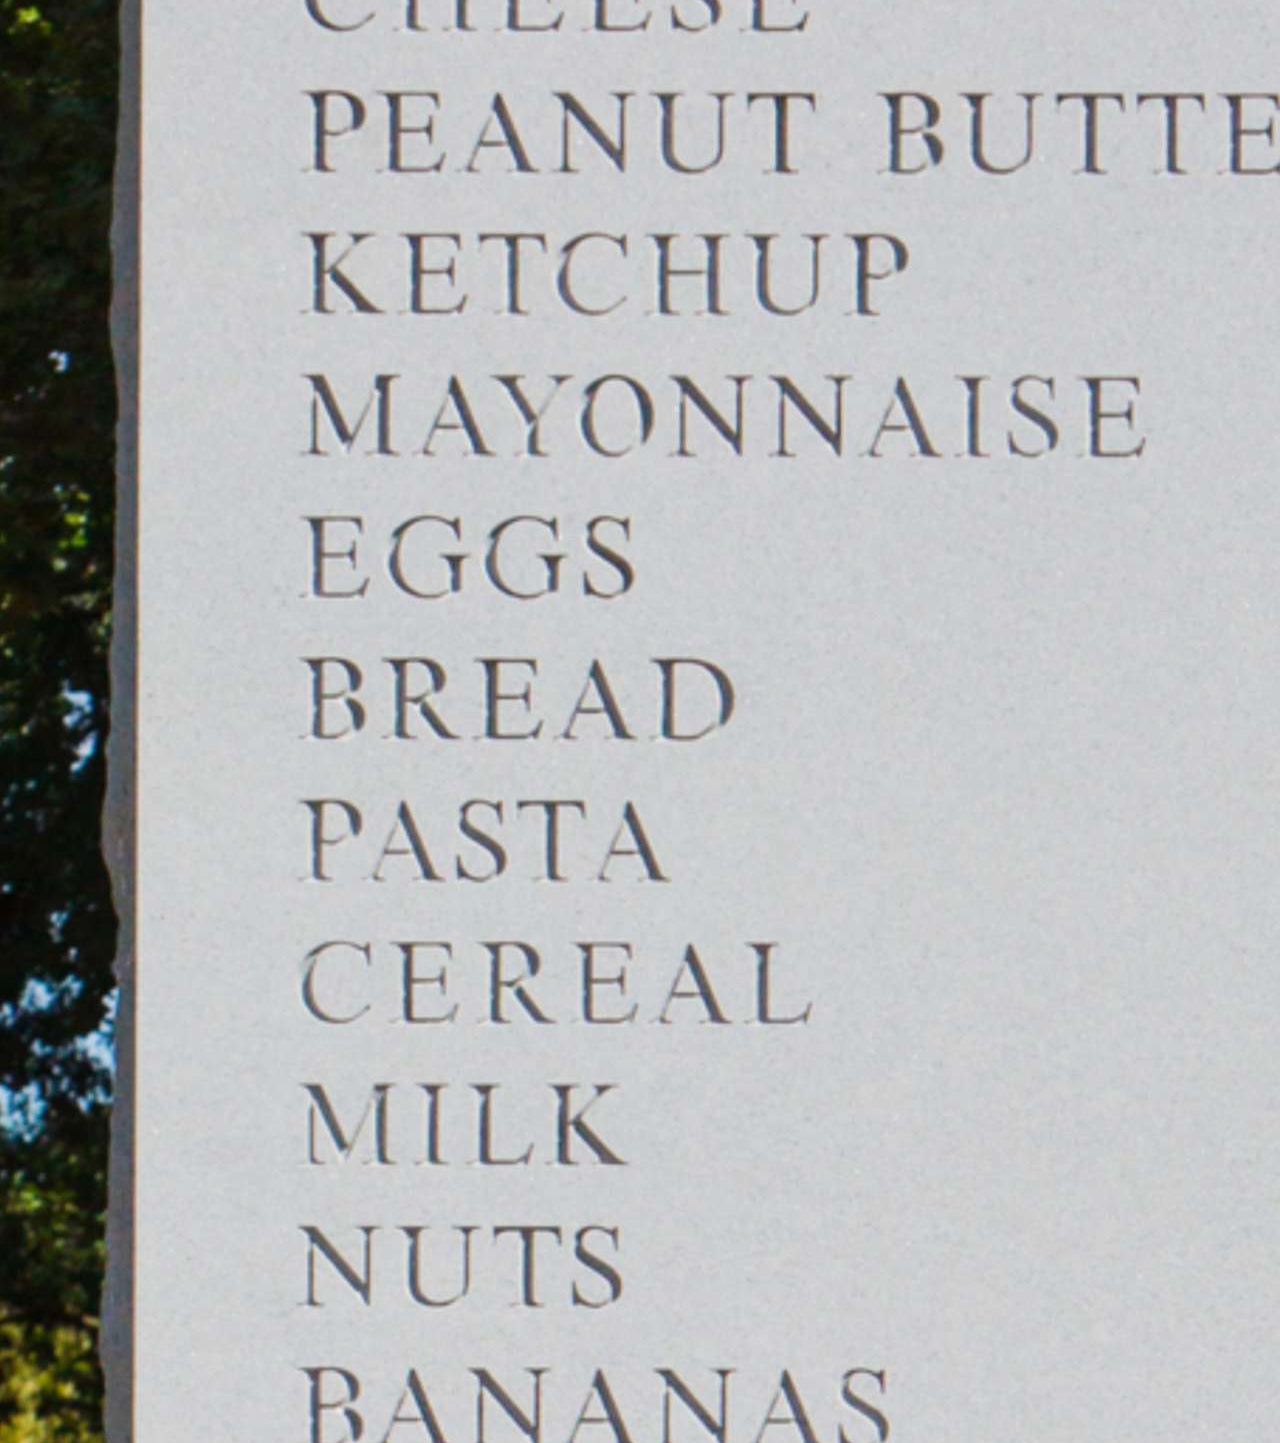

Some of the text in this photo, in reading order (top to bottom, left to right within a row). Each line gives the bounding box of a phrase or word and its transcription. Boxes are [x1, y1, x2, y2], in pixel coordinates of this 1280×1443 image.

[302, 88, 817, 175] PEANUT
[301, 231, 910, 317] KETCHUP
[300, 373, 1146, 459] MAYONNAISE
[301, 514, 635, 601] EGGS
[300, 656, 736, 742] BREAD
[298, 798, 670, 883] PASTA
[301, 940, 812, 1025] CEREAL
[300, 1082, 629, 1167] MILK
[298, 1224, 623, 1309] NUTS
